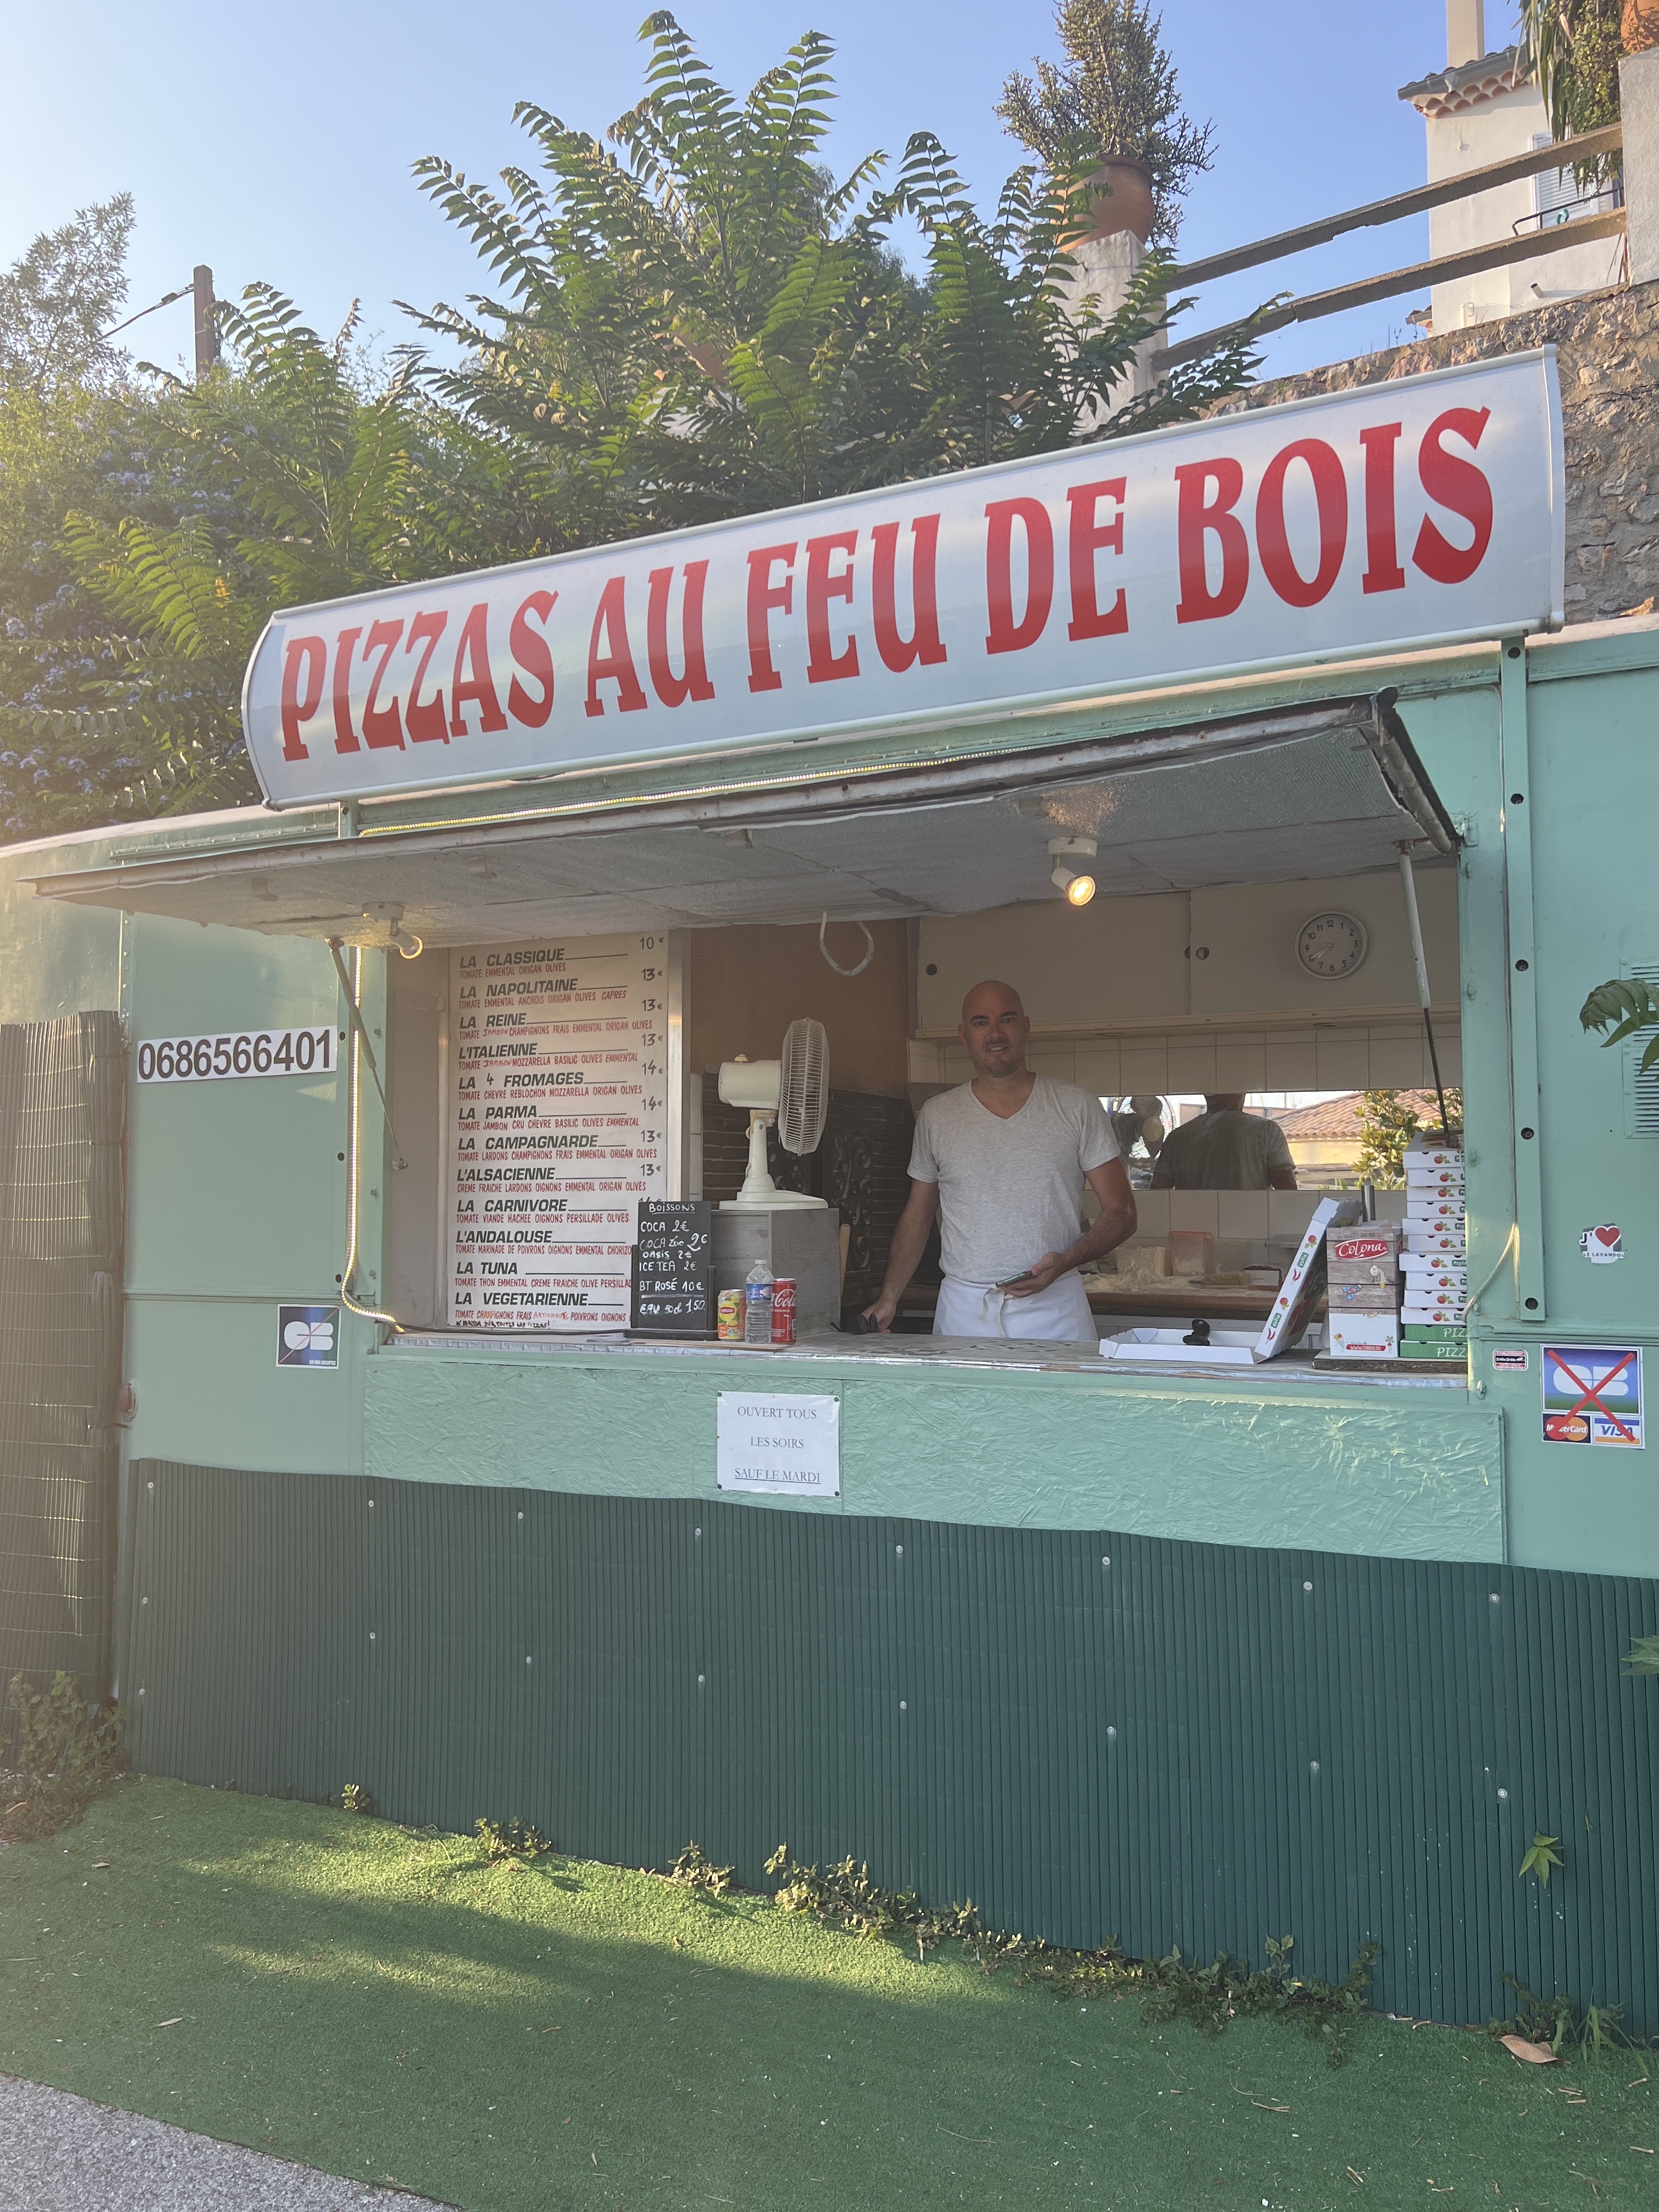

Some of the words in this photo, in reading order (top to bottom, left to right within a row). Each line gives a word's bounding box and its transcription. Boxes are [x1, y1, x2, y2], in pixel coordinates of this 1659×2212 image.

[281, 590, 558, 762] PIZZAS
[584, 560, 716, 717] AU
[746, 513, 947, 693] FEU
[985, 477, 1128, 656] DE
[1175, 407, 1493, 625] BOIS
[460, 956, 476, 968] LA
[487, 948, 565, 967] CLASSIQUE
[460, 969, 482, 979] TOMATE
[486, 967, 515, 978] EMMENTAL
[519, 964, 541, 975] ORIGAN
[545, 962, 566, 973] OLIVES
[460, 986, 476, 998] LA
[486, 978, 578, 997] NAPOLITAINE
[459, 1000, 481, 1009] TOMATE
[484, 997, 514, 1007] EMMENTAL
[518, 995, 544, 1006] ANCHOIS
[548, 994, 571, 1003] ORIGAN
[575, 992, 596, 1002] OLIVES
[601, 990, 626, 1001] CAPRES
[460, 1017, 476, 1029] LA
[486, 1013, 526, 1027] REINE
[459, 1031, 479, 1040] TOMATE
[482, 1028, 509, 1036] JAMBON
[509, 1025, 549, 1036] CHAMPIGNONS
[553, 1024, 569, 1034] FRAIS
[573, 1022, 602, 1032] EMMENTAL
[606, 1020, 628, 1030] ORIGAN
[632, 1020, 652, 1030] OLIVES
[138, 1029, 330, 1080] 0686566401
[459, 1043, 537, 1059] L'ITALIENNE
[459, 1061, 480, 1070] TOMATE
[483, 1059, 512, 1068] JAMBON
[512, 1057, 551, 1066] MOZZARELLA
[555, 1056, 578, 1065] BASILIC
[581, 1054, 602, 1064] OLIVES
[605, 1053, 638, 1062] EMMENTAL
[459, 1077, 476, 1089] LA
[487, 1073, 494, 1086] 4
[504, 1072, 584, 1087] FROMAGES
[459, 1091, 480, 1101] TOMATE
[484, 1090, 506, 1099] CHEVRE
[510, 1088, 546, 1098] REBLOCHON
[550, 1087, 589, 1097] MOZZARELLA
[593, 1086, 617, 1096] ORIGAN
[620, 1085, 642, 1094] OLIVES
[459, 1108, 476, 1120] LA
[486, 1105, 537, 1119] PARMA
[458, 1121, 480, 1131] TOMATE
[483, 1121, 507, 1131] JAMBON
[512, 1119, 524, 1128] CRU
[528, 1119, 551, 1128] CHEVRE
[555, 1119, 578, 1128] BASILIC
[583, 1118, 603, 1127] OLIVES
[606, 1117, 639, 1126] EMMENTAL
[459, 1138, 475, 1150] LA
[486, 1135, 598, 1149] CAMPAGNARDE
[458, 1152, 479, 1161] TOMATE
[482, 1151, 507, 1161] LARDONS
[512, 1150, 552, 1160] CHAMPIGNONS
[556, 1150, 572, 1159] FRAIS
[576, 1149, 606, 1159] EMMENTAL
[610, 1149, 633, 1158] ORIGAN
[636, 1149, 657, 1158] OLIVES
[457, 1167, 555, 1181] L'ALSACIENNE
[457, 1183, 476, 1193] CREME
[479, 1183, 501, 1193] FRAICHE
[505, 1183, 532, 1192] LARDONS
[535, 1182, 561, 1192] OIGNONS
[565, 1182, 595, 1191] EMMENTAL
[599, 1182, 622, 1191] ORIGAN
[625, 1181, 646, 1190] OLIVES
[457, 1200, 474, 1212] LA
[484, 1199, 567, 1211] CARNIVORE
[456, 1214, 479, 1223] TOMATE
[483, 1214, 504, 1223] VIANDE
[508, 1214, 531, 1223] HACHEE
[535, 1214, 563, 1223] OIGNONS
[567, 1214, 603, 1222] PERSILLADE
[607, 1213, 629, 1222] OLIVES
[640, 1222, 665, 1232] COCA
[672, 1220, 689, 1232] 2€
[456, 1231, 552, 1243] L'ANDALOUSE
[456, 1245, 475, 1254] TOMATE
[478, 1245, 505, 1254] MARINADE
[508, 1245, 515, 1254] DE
[518, 1245, 545, 1254] POIVRONS
[548, 1245, 572, 1254] OIGNONS
[576, 1245, 603, 1254] EMMENTAL
[607, 1245, 631, 1254] CHORIZO
[639, 1238, 666, 1251] COCA
[1339, 1240, 1383, 1258] Colona
[457, 1262, 473, 1274] LA
[481, 1262, 517, 1274] TUNA
[639, 1262, 654, 1272] ICE
[657, 1261, 675, 1271] TEA
[684, 1261, 697, 1271] 2€
[455, 1278, 476, 1287] TOMATE
[480, 1278, 494, 1286] THON
[498, 1278, 527, 1286] EMMENTAL
[531, 1278, 550, 1287] CREME
[554, 1279, 578, 1287] FRAICHE
[581, 1279, 597, 1288] OLIVE
[640, 1281, 652, 1291] BT
[655, 1278, 678, 1291] ROSÉ
[682, 1282, 704, 1292] 10€
[455, 1293, 472, 1305] LA
[483, 1293, 588, 1306] VEGETARIENNE
[455, 1310, 473, 1318] TOMATE
[477, 1310, 514, 1319] CHAMPIGNONS
[516, 1311, 532, 1319] FRAIS
[571, 1312, 598, 1321] POIVRONS
[602, 1312, 625, 1322] OIGNONS
[1437, 1347, 1467, 1357] PIZZ
[738, 1407, 783, 1418] OUVERT
[786, 1409, 816, 1419] TOUS
[751, 1437, 769, 1447] LES
[773, 1438, 804, 1448] SOIRS
[735, 1468, 762, 1479] SAUF
[765, 1470, 779, 1480] LE
[783, 1471, 820, 1482] MARDI
